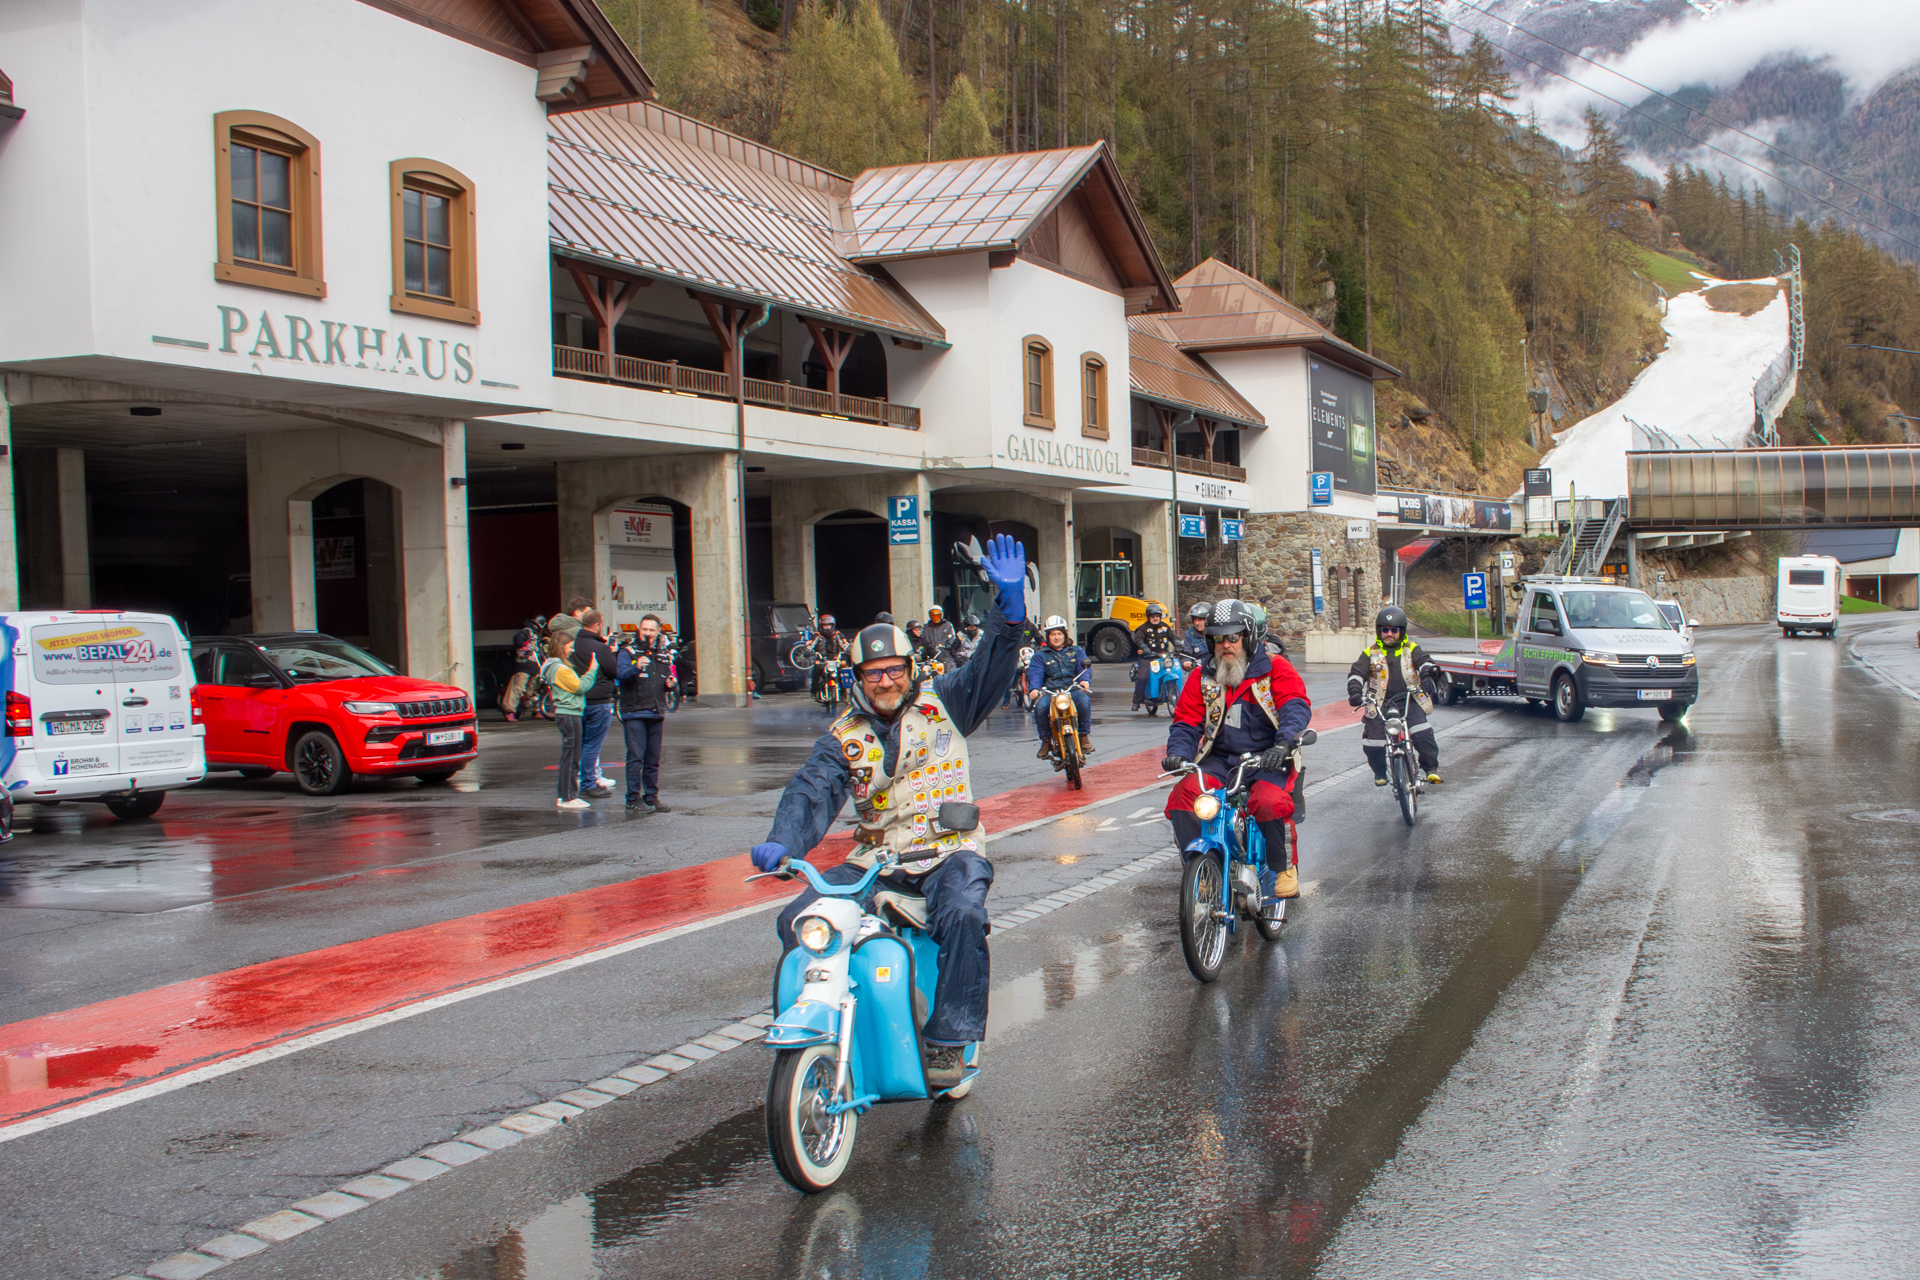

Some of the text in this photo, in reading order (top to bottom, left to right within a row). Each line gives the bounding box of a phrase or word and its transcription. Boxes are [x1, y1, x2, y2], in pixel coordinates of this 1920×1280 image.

[217, 305, 475, 384] PARKHAUS
[1313, 406, 1346, 430] ELEMENTS
[1007, 434, 1122, 475] GAISLACHKOGL
[1202, 482, 1226, 500] EINFAHRT
[896, 498, 910, 518] P
[891, 518, 918, 526] KASSA
[1504, 560, 1512, 568] D
[1466, 576, 1482, 596] P
[618, 600, 668, 611] www.klvrent.at
[49, 628, 132, 648] JETZT ONLINE SHOPPEN
[1524, 648, 1575, 663] SCHLEPPHILFE
[54, 720, 104, 733] HD MA 2925
[70, 762, 109, 770] HOHENADEL
